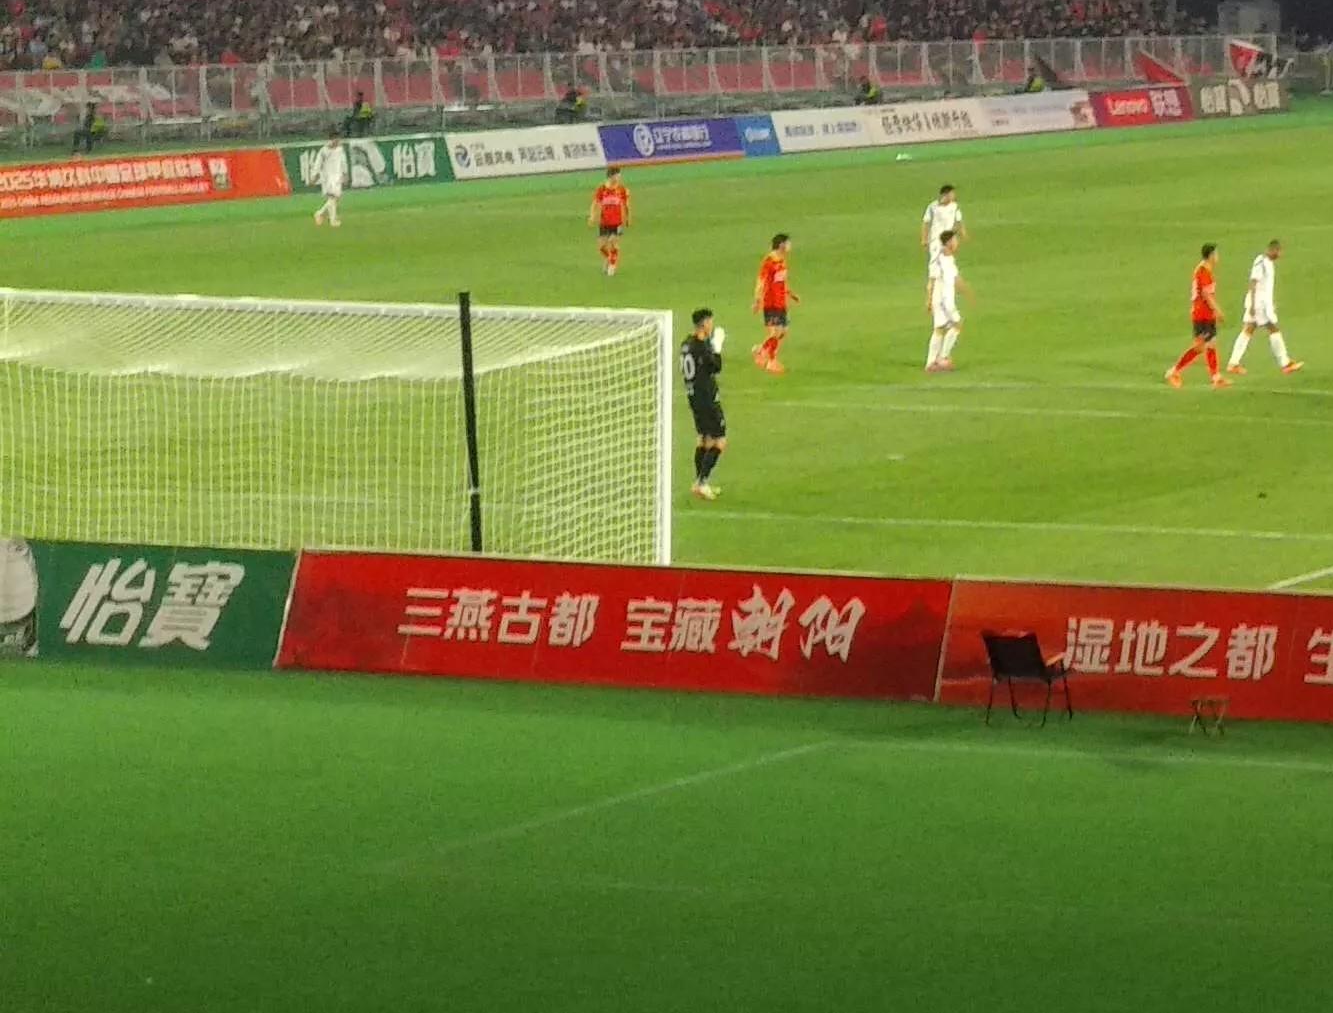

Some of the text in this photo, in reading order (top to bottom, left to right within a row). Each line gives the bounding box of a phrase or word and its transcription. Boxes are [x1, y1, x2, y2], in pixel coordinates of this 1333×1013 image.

[58, 557, 246, 651] 怡寶
[396, 583, 868, 663] 三燕古都 宝藏朝阳
[1063, 617, 1280, 681] 湿地之都
